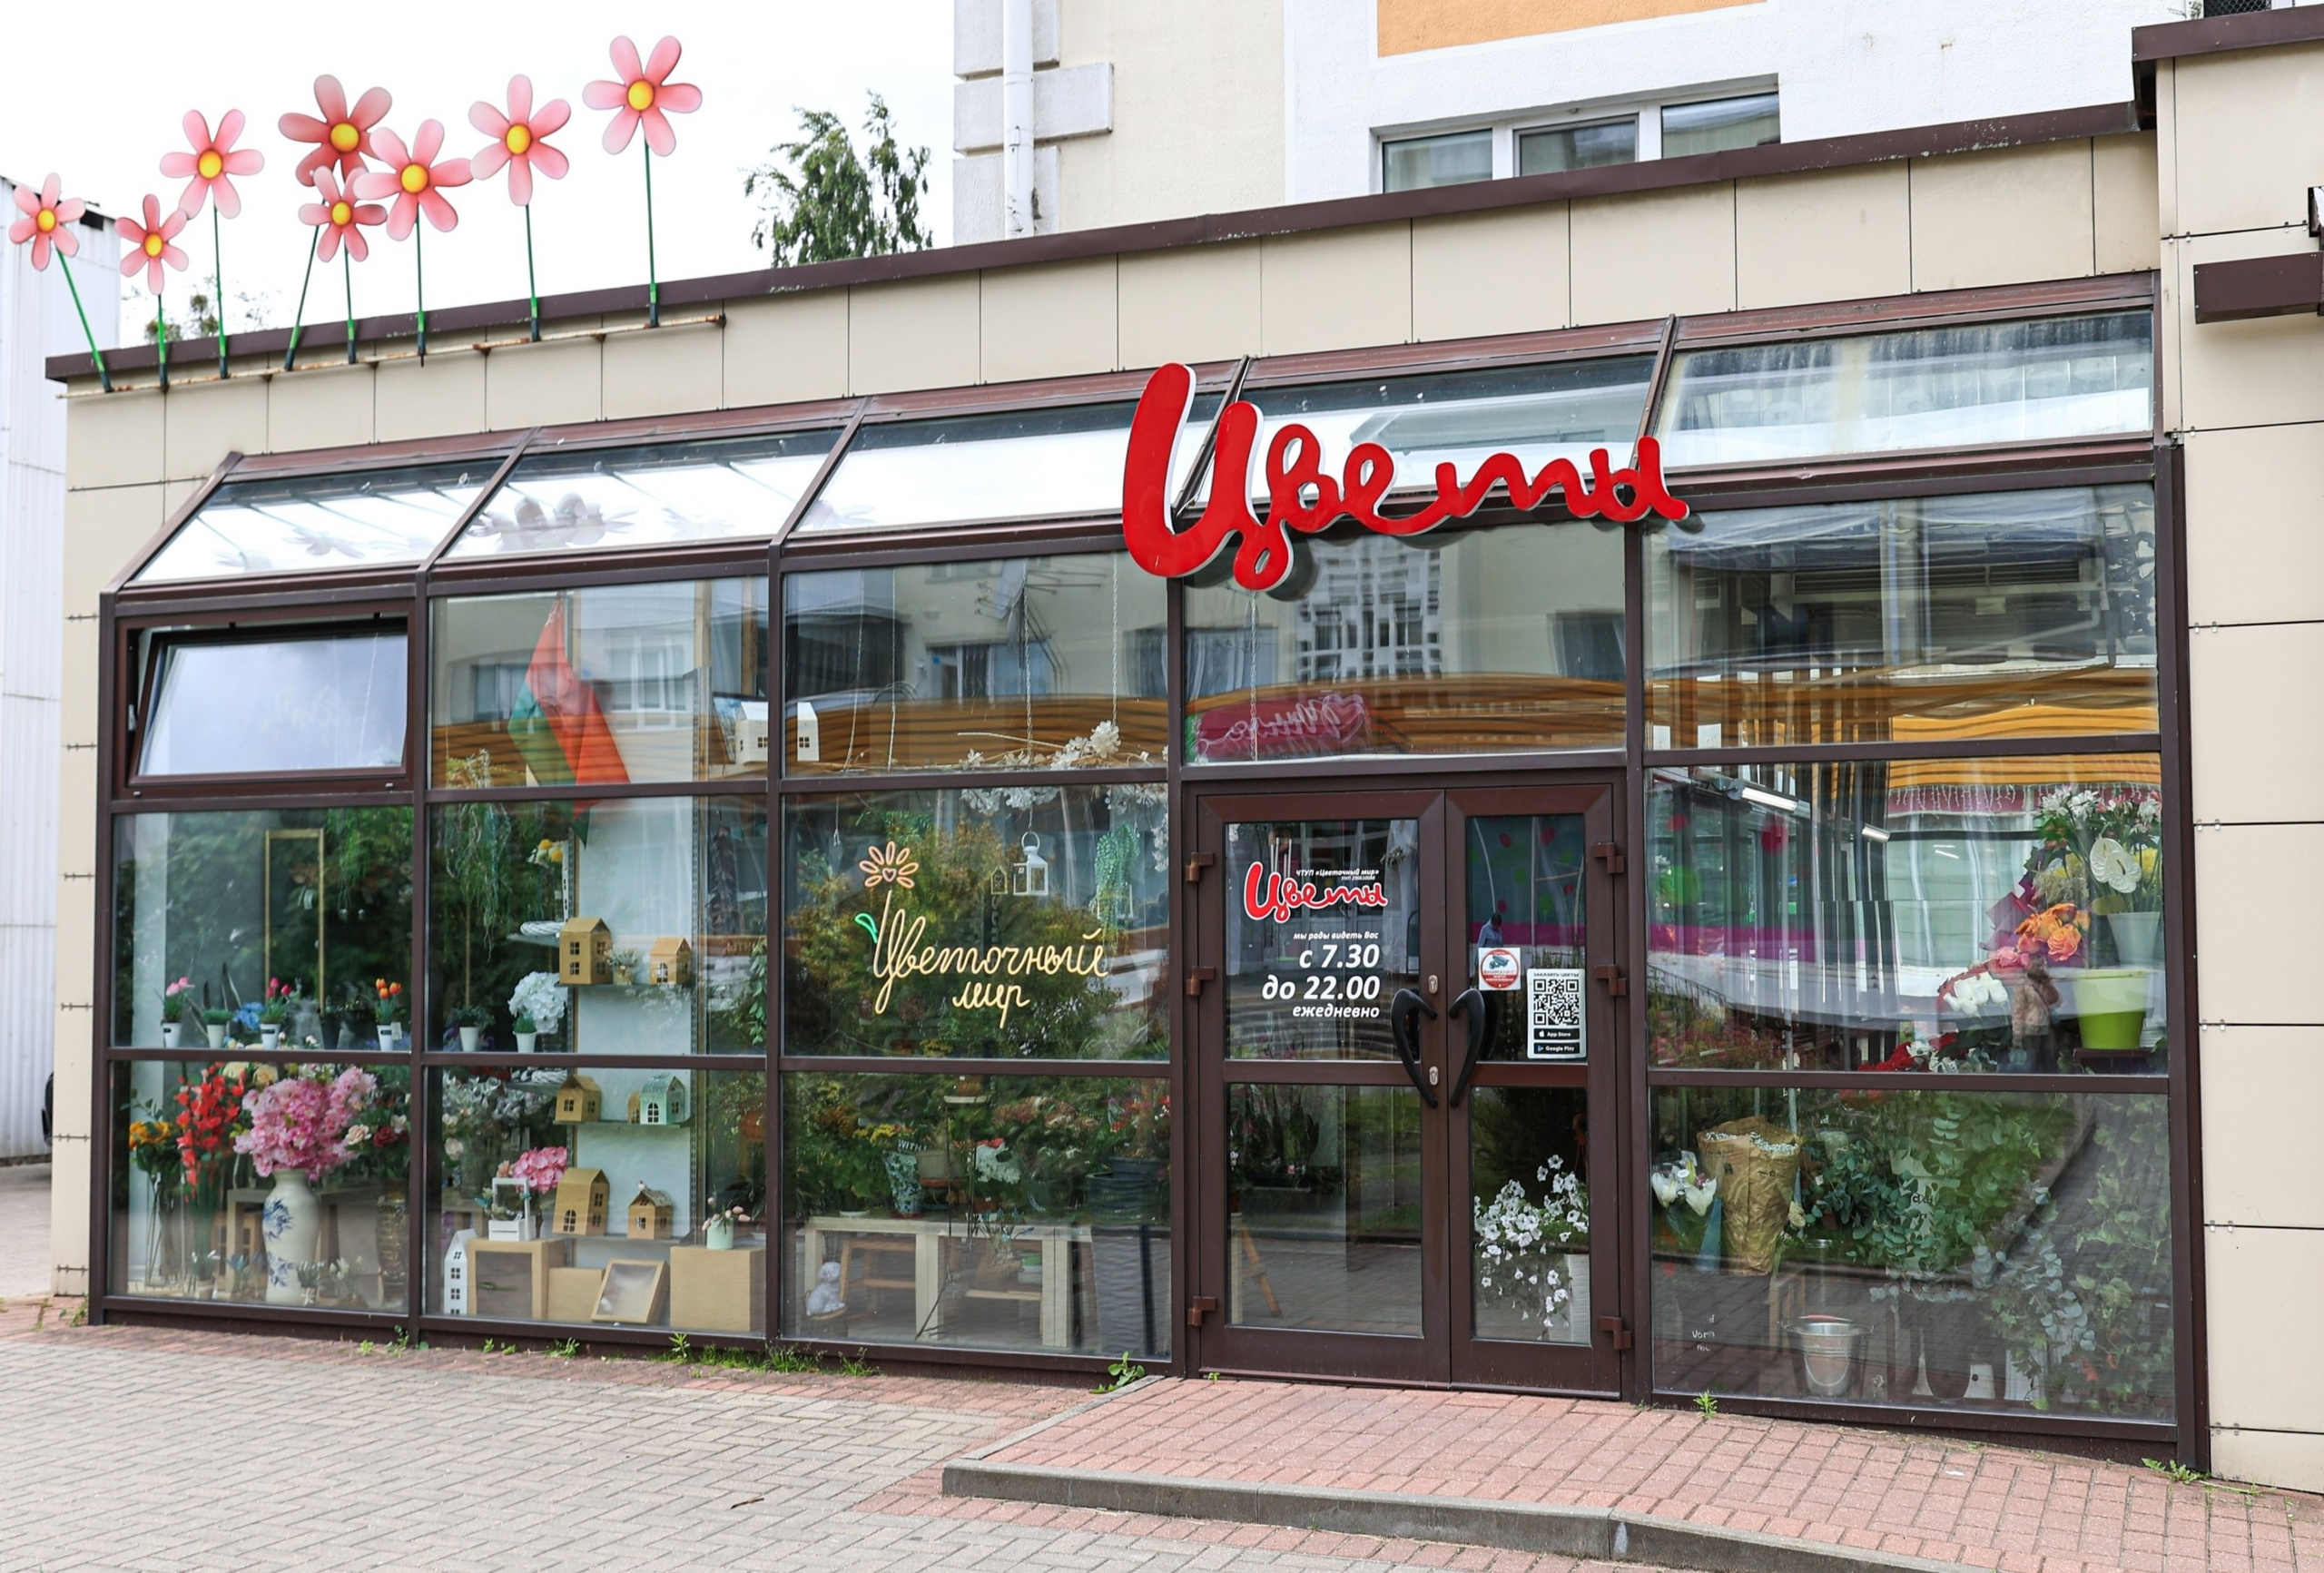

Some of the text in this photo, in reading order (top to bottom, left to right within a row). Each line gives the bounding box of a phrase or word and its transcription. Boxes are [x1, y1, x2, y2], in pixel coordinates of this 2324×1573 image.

[1122, 362, 1690, 591] Цветы
[1244, 861, 1388, 923] Цветы
[872, 890, 1108, 1015] Цветочный
[1293, 930, 1380, 941] мы рады видеть Вас
[1299, 944, 1380, 969] с 7.30
[952, 981, 1030, 1029] мир
[1262, 974, 1381, 1000] до 22.00
[1292, 1002, 1381, 1018] ежедневно
